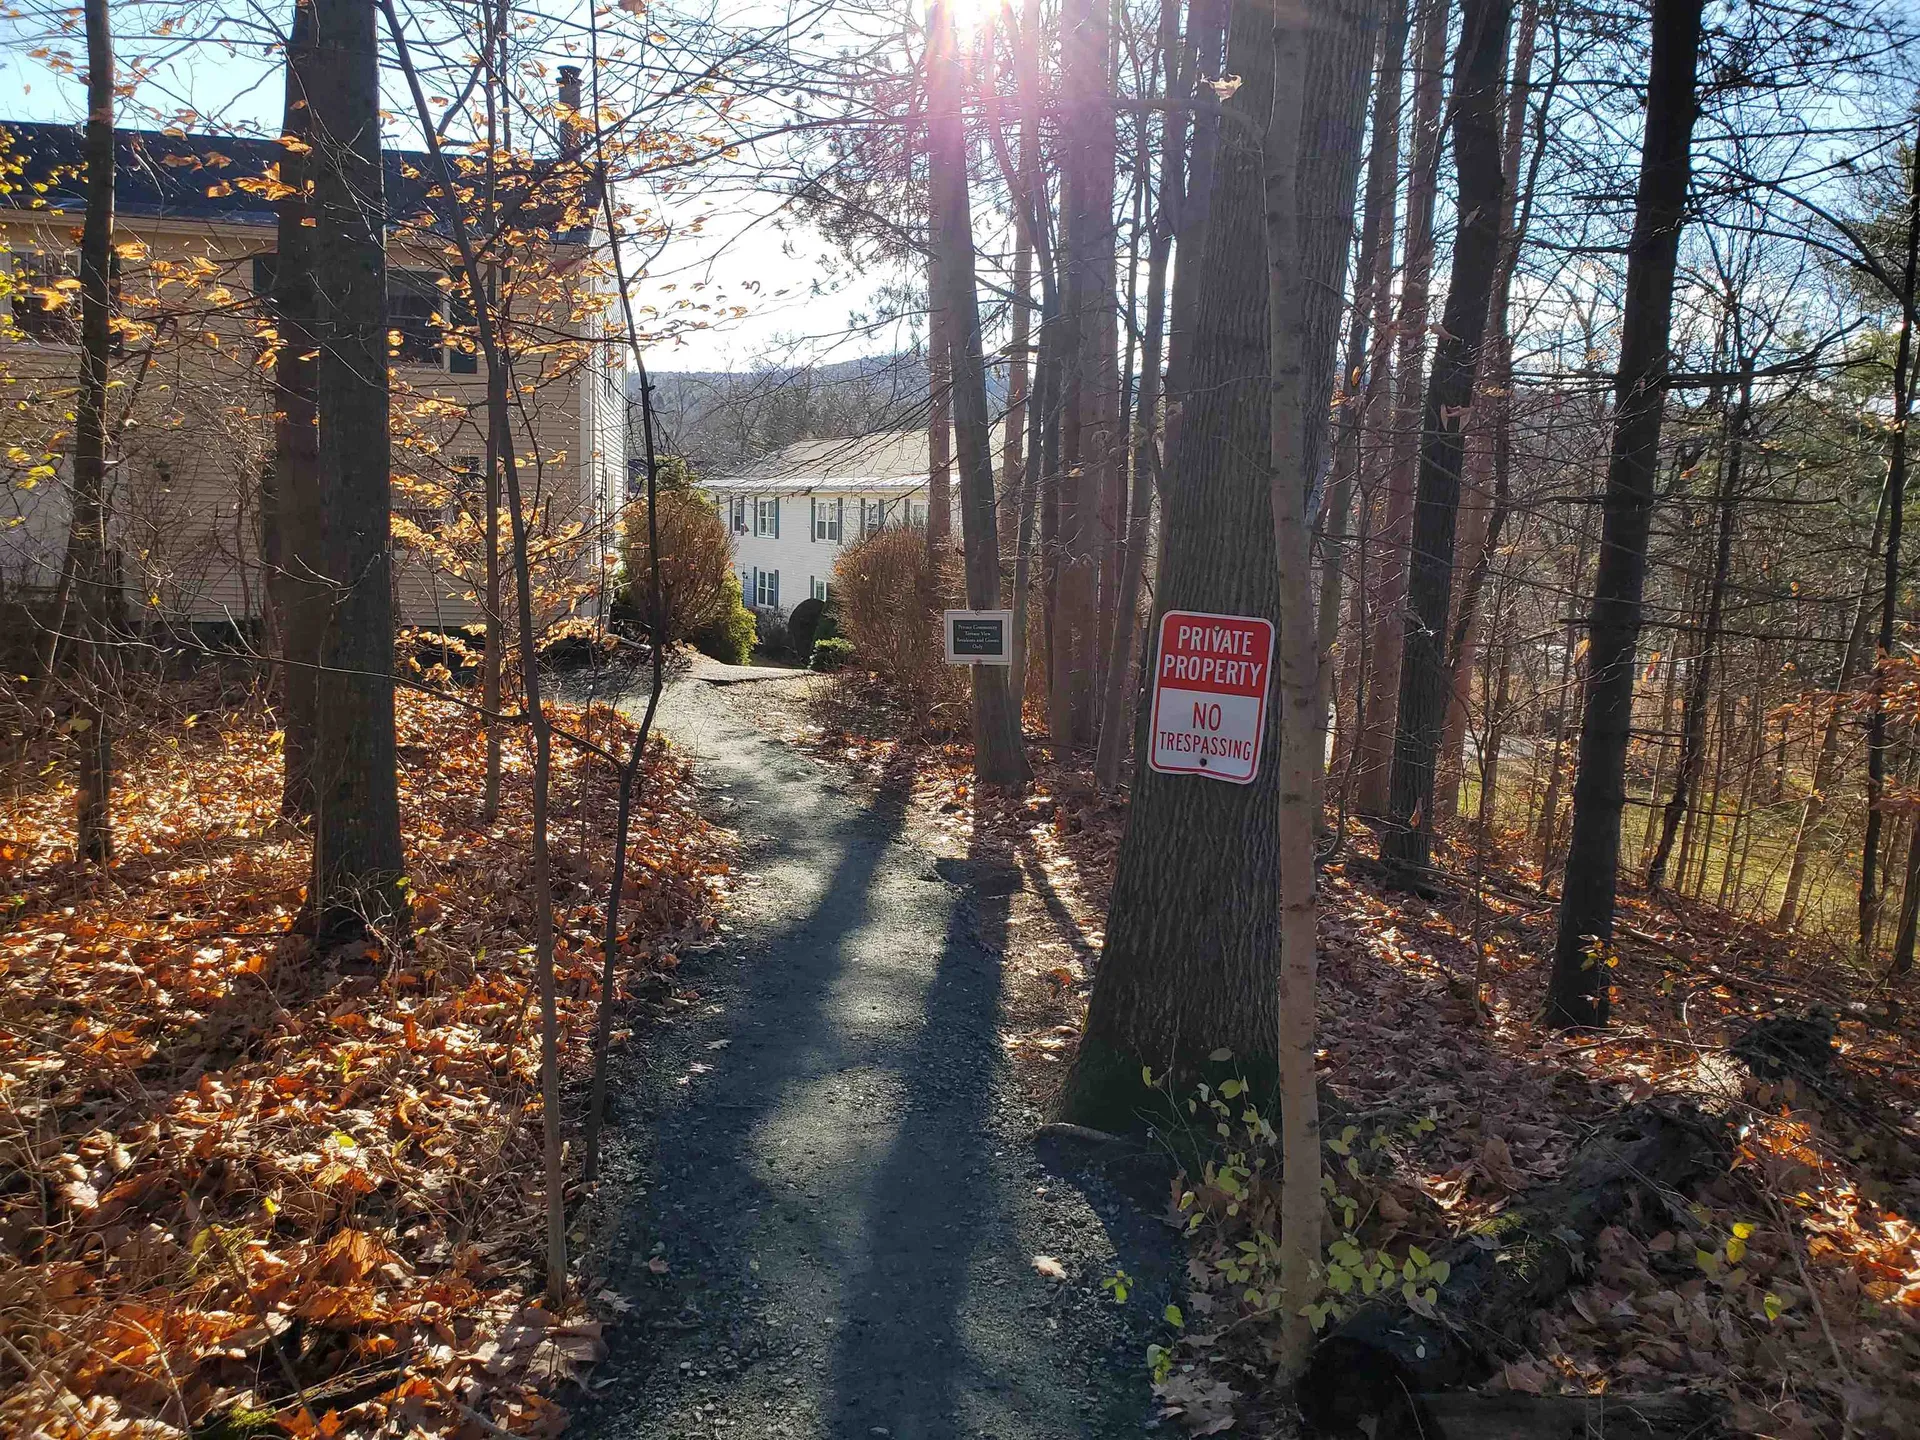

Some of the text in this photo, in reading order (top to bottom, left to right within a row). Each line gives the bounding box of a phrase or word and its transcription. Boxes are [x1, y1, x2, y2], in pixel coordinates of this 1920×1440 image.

[1178, 625, 1254, 656] PRIVATE
[1163, 654, 1263, 687] PROPERTY
[1192, 701, 1222, 731] NO
[1160, 731, 1252, 761] TRESPASSING
